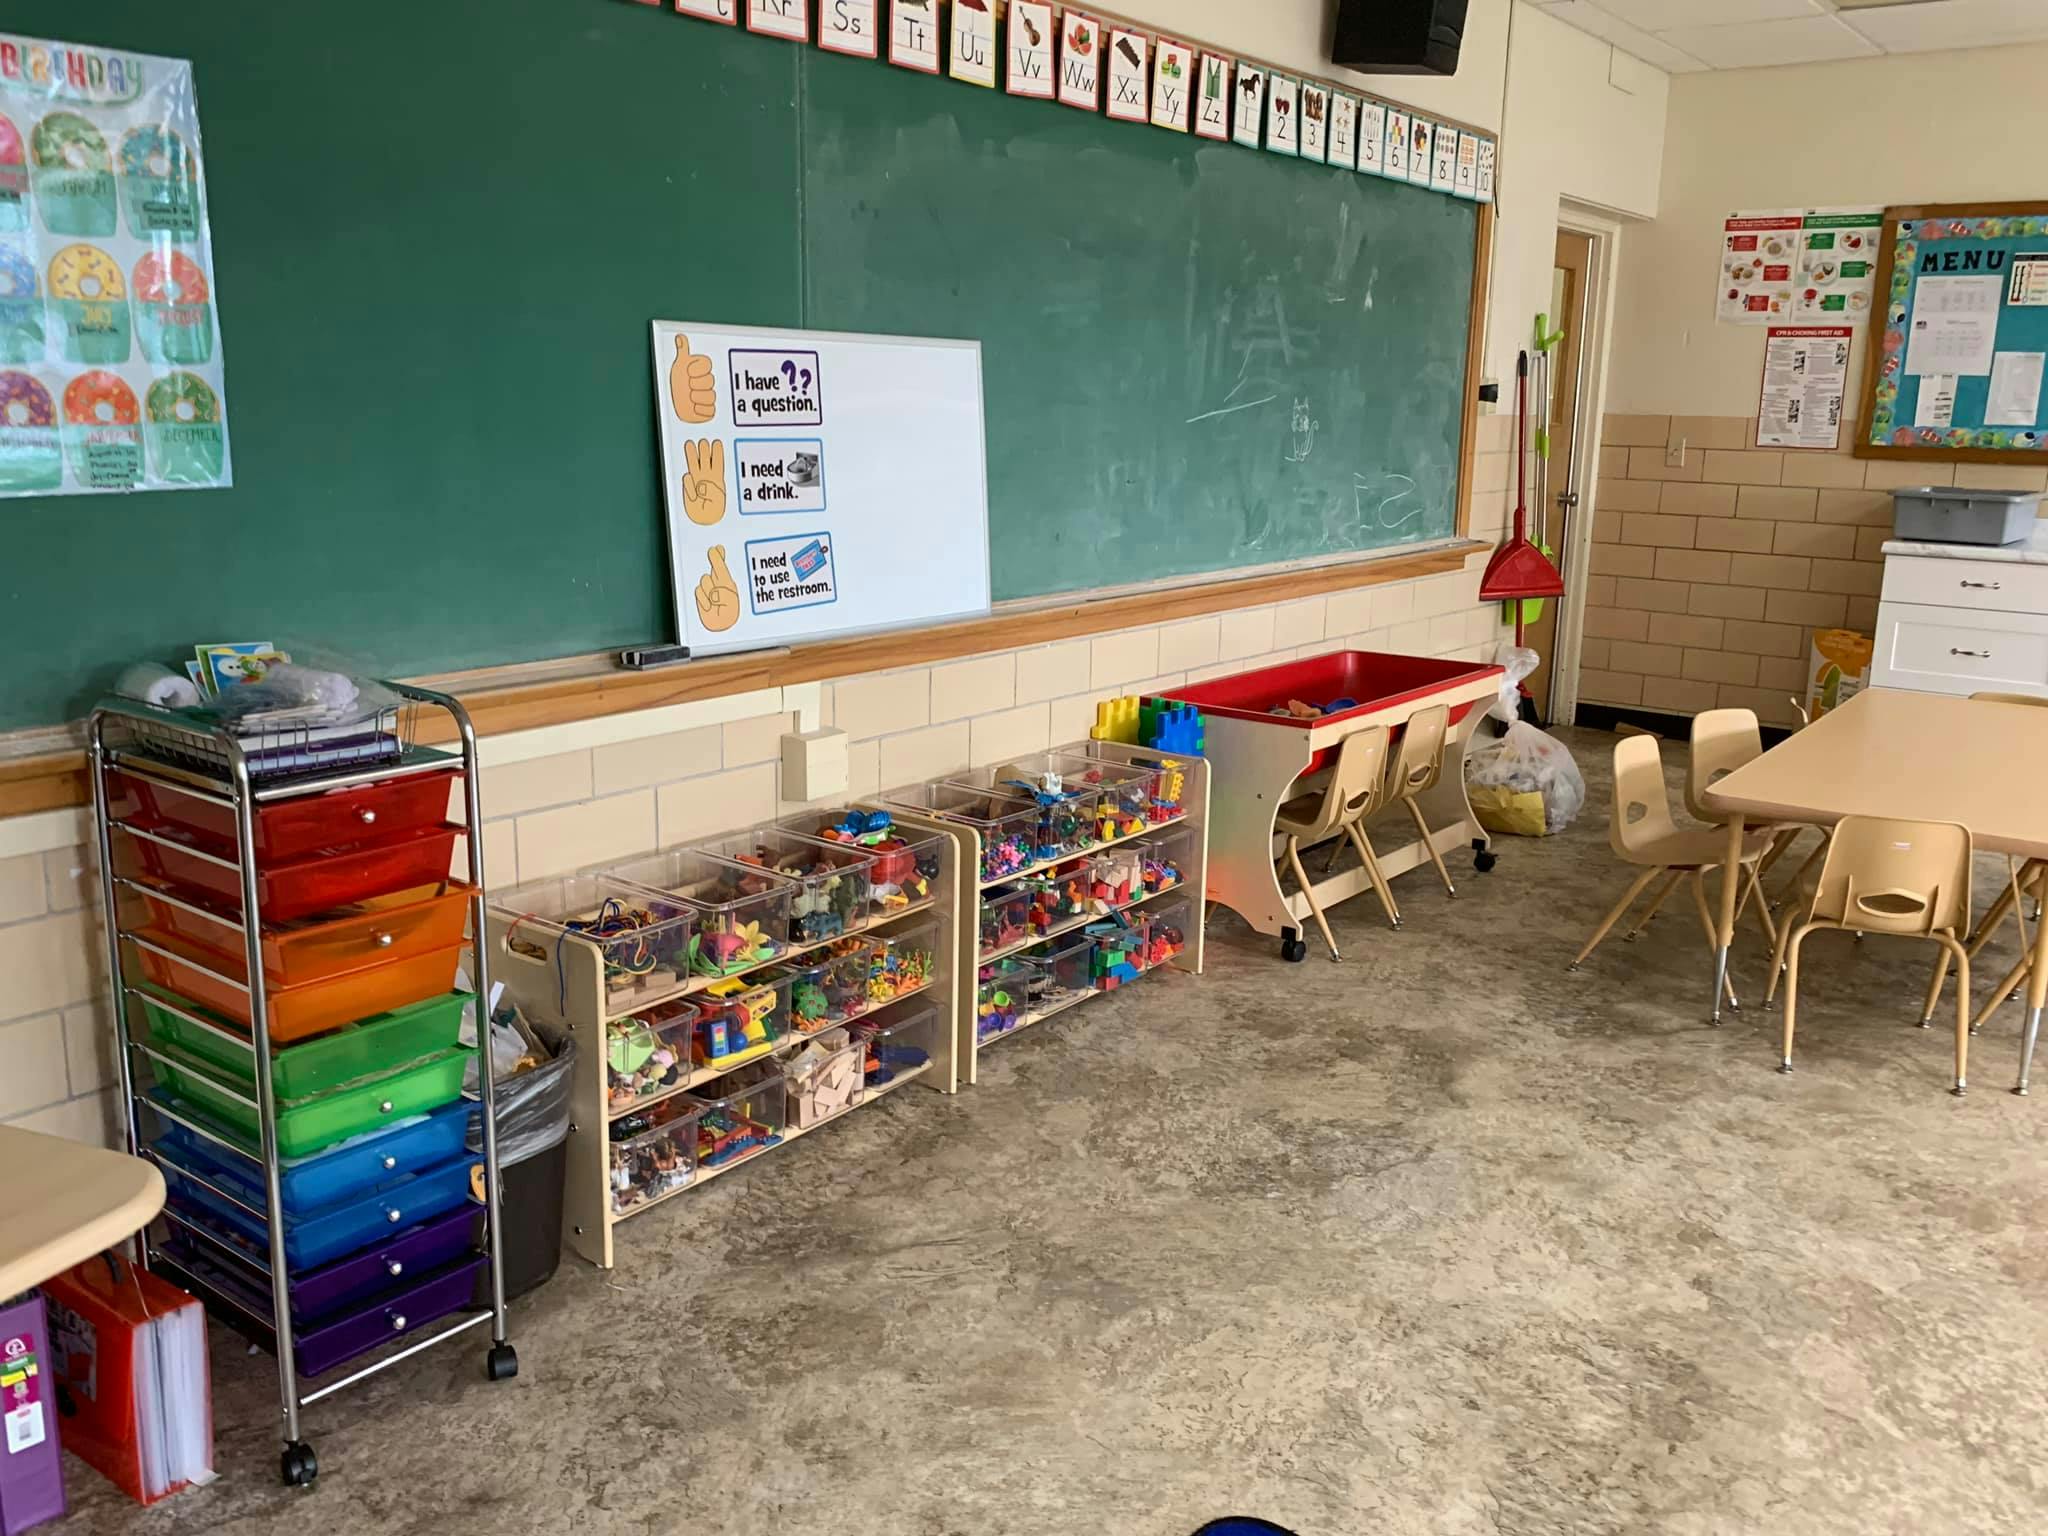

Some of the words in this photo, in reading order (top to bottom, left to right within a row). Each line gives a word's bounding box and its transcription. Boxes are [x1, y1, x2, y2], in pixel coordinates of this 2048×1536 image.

[834, 0, 860, 34] Ss
[904, 17, 925, 51] Tt
[961, 32, 983, 65] Uu
[1019, 48, 1040, 78] Vv
[1064, 57, 1095, 92] Ww
[1116, 75, 1138, 105] Xx
[1163, 84, 1179, 123] Yy
[1204, 97, 1220, 124] Zz
[1277, 116, 1286, 139] 2
[1308, 123, 1316, 145] 3
[1337, 131, 1346, 153] 4
[1366, 139, 1374, 160] 5
[1391, 146, 1399, 167] 6
[1415, 153, 1422, 172] 7
[1439, 160, 1446, 180] 8
[1461, 167, 1468, 185] 9
[1921, 250, 2005, 272] MENU
[735, 373, 740, 390] I
[745, 369, 780, 391] have
[737, 398, 746, 413] a
[752, 395, 817, 417] question.
[741, 461, 746, 478] I
[751, 459, 783, 478] need
[743, 488, 752, 501] a
[757, 481, 799, 501] drink.
[752, 557, 756, 571] I
[760, 552, 786, 569] need
[754, 574, 766, 587] to
[770, 571, 790, 585] use
[756, 587, 775, 603] the
[778, 582, 832, 599] restroom.
